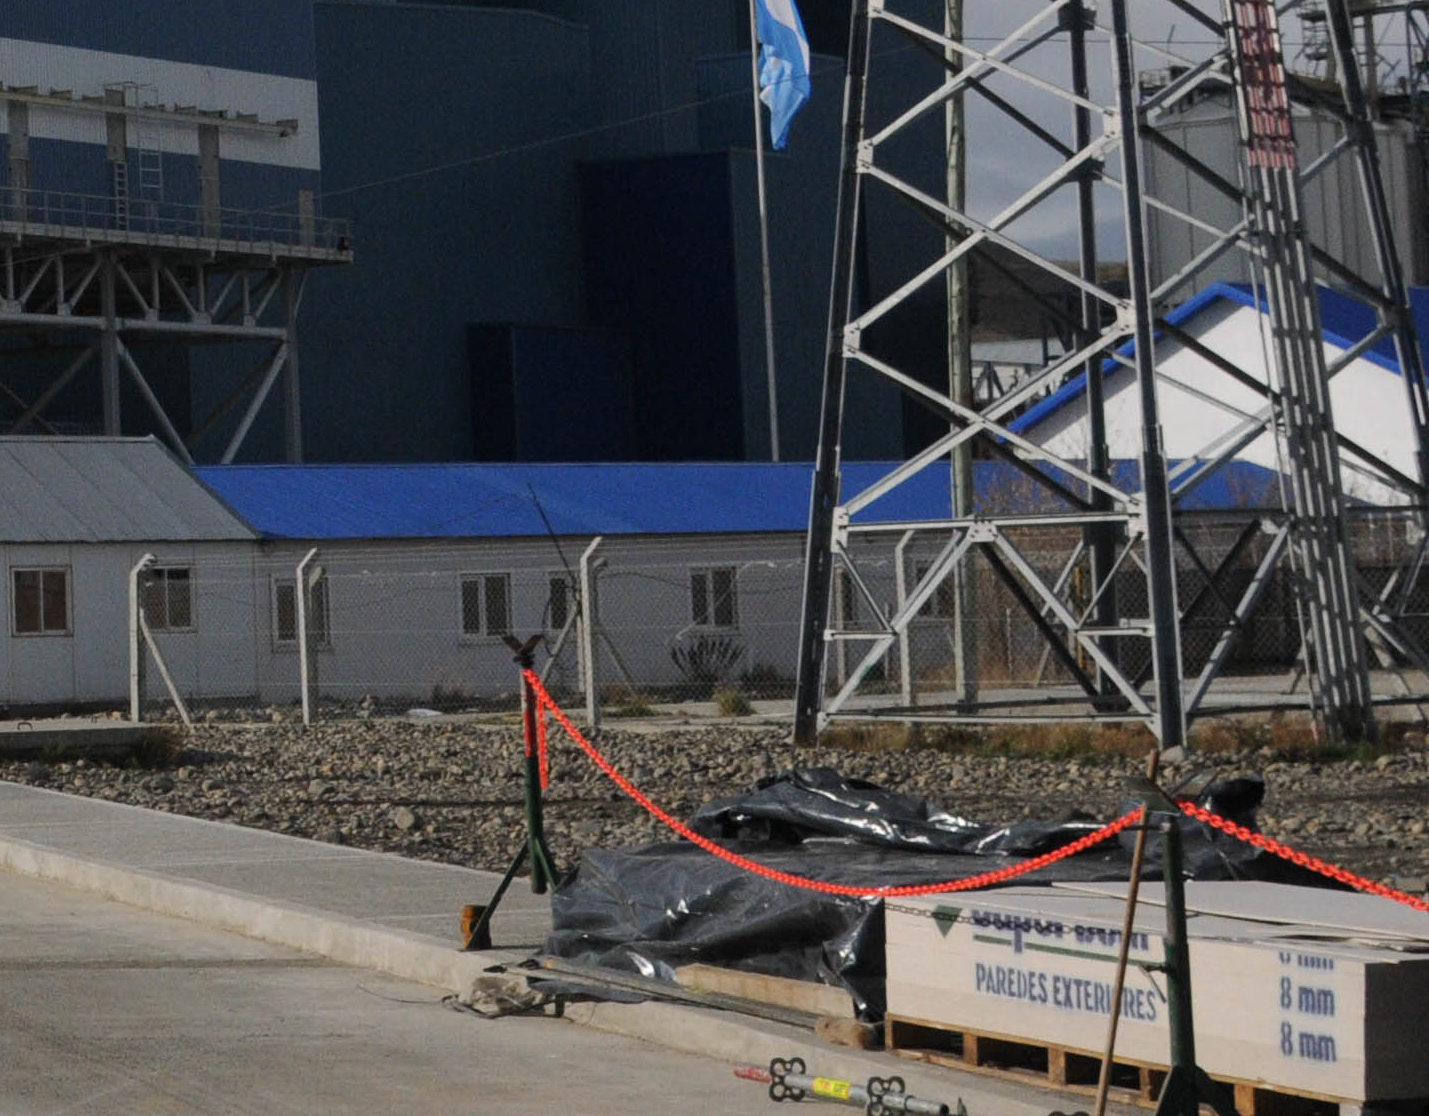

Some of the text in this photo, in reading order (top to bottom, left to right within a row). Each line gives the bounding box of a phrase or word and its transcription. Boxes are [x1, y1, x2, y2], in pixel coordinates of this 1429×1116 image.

[976, 963, 1158, 1022] PAREDES EXTERIRES
[1280, 976, 1336, 1016] 8 mm
[1280, 1021, 1338, 1062] 8 mm
